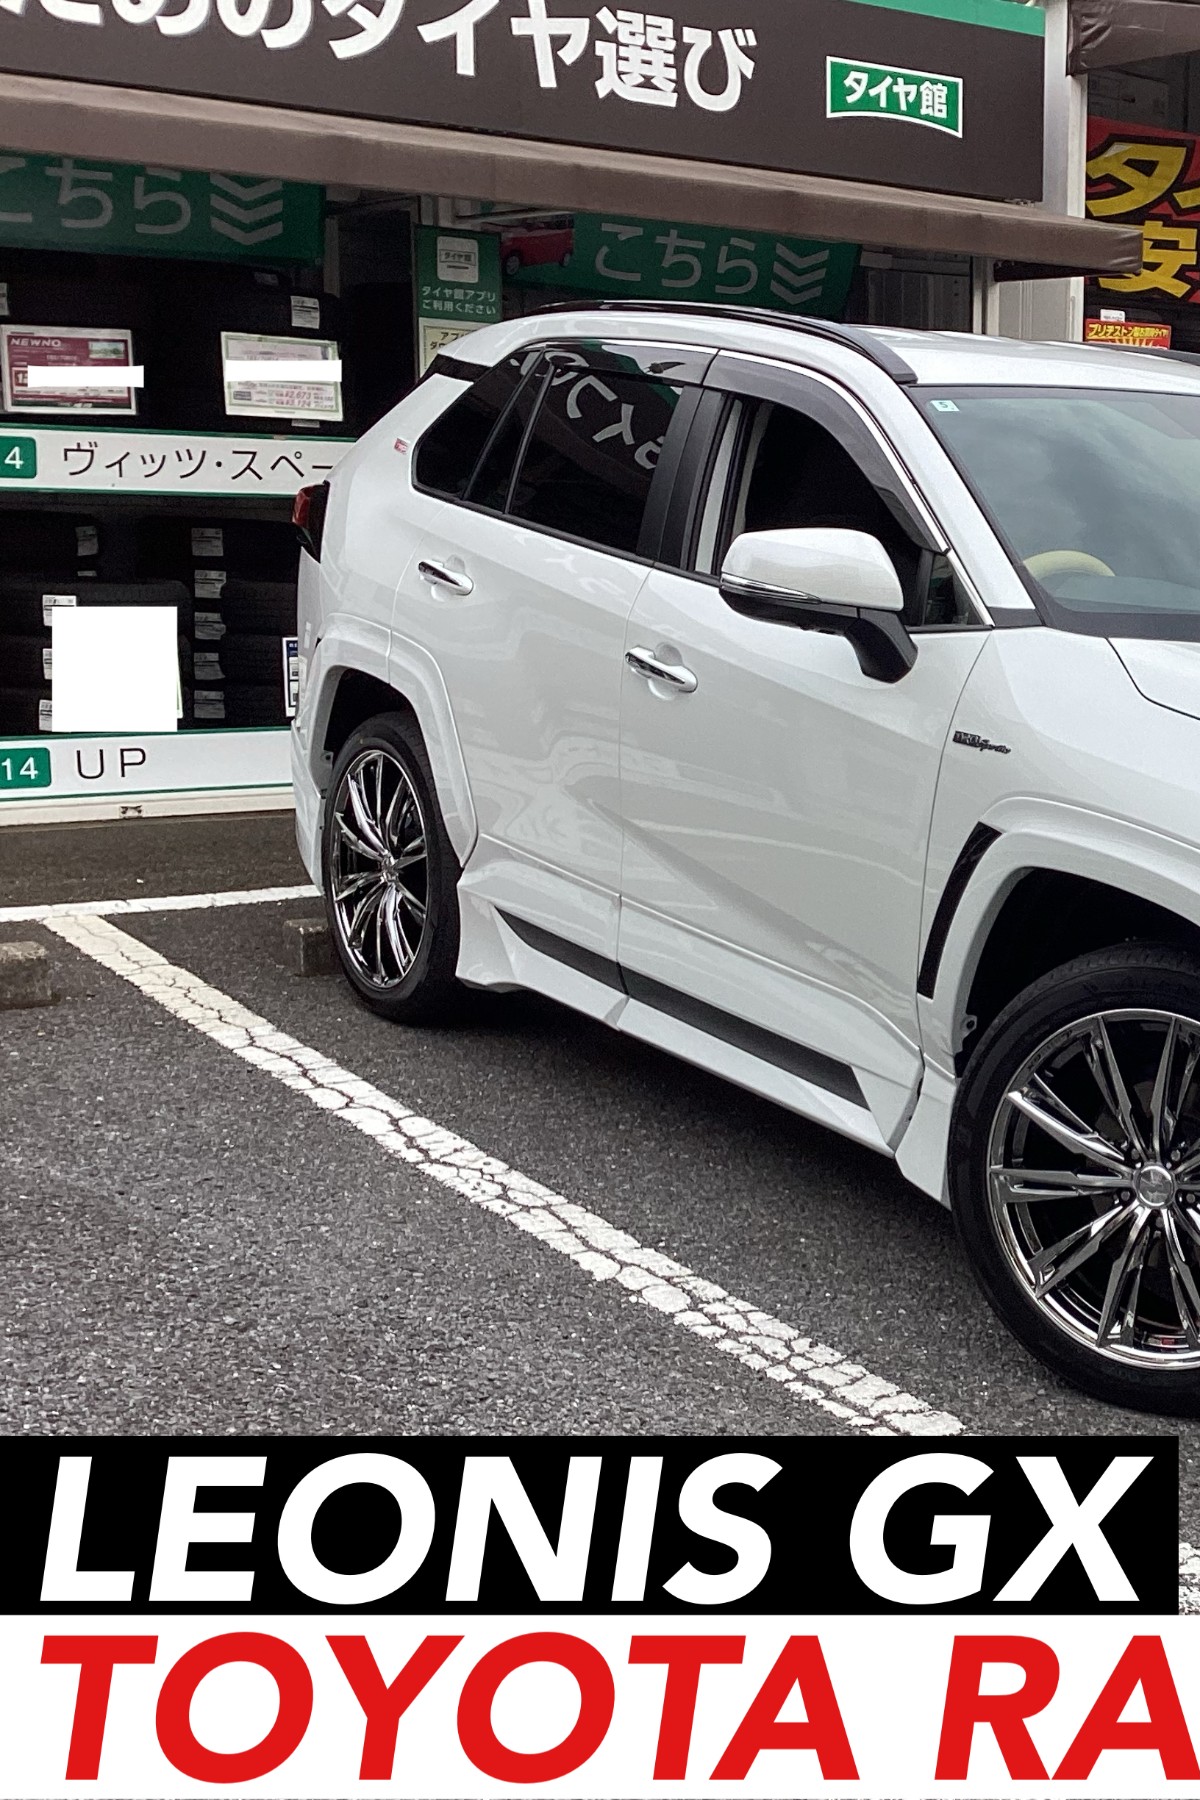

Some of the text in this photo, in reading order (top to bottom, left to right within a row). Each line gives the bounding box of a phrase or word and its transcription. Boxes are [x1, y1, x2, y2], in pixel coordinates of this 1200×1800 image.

[843, 70, 948, 120] タイヤ館
[595, 222, 759, 295] こちら
[421, 300, 496, 315] ご利用ください
[11, 338, 61, 347] NEWNO
[1, 748, 147, 780] 14 UP
